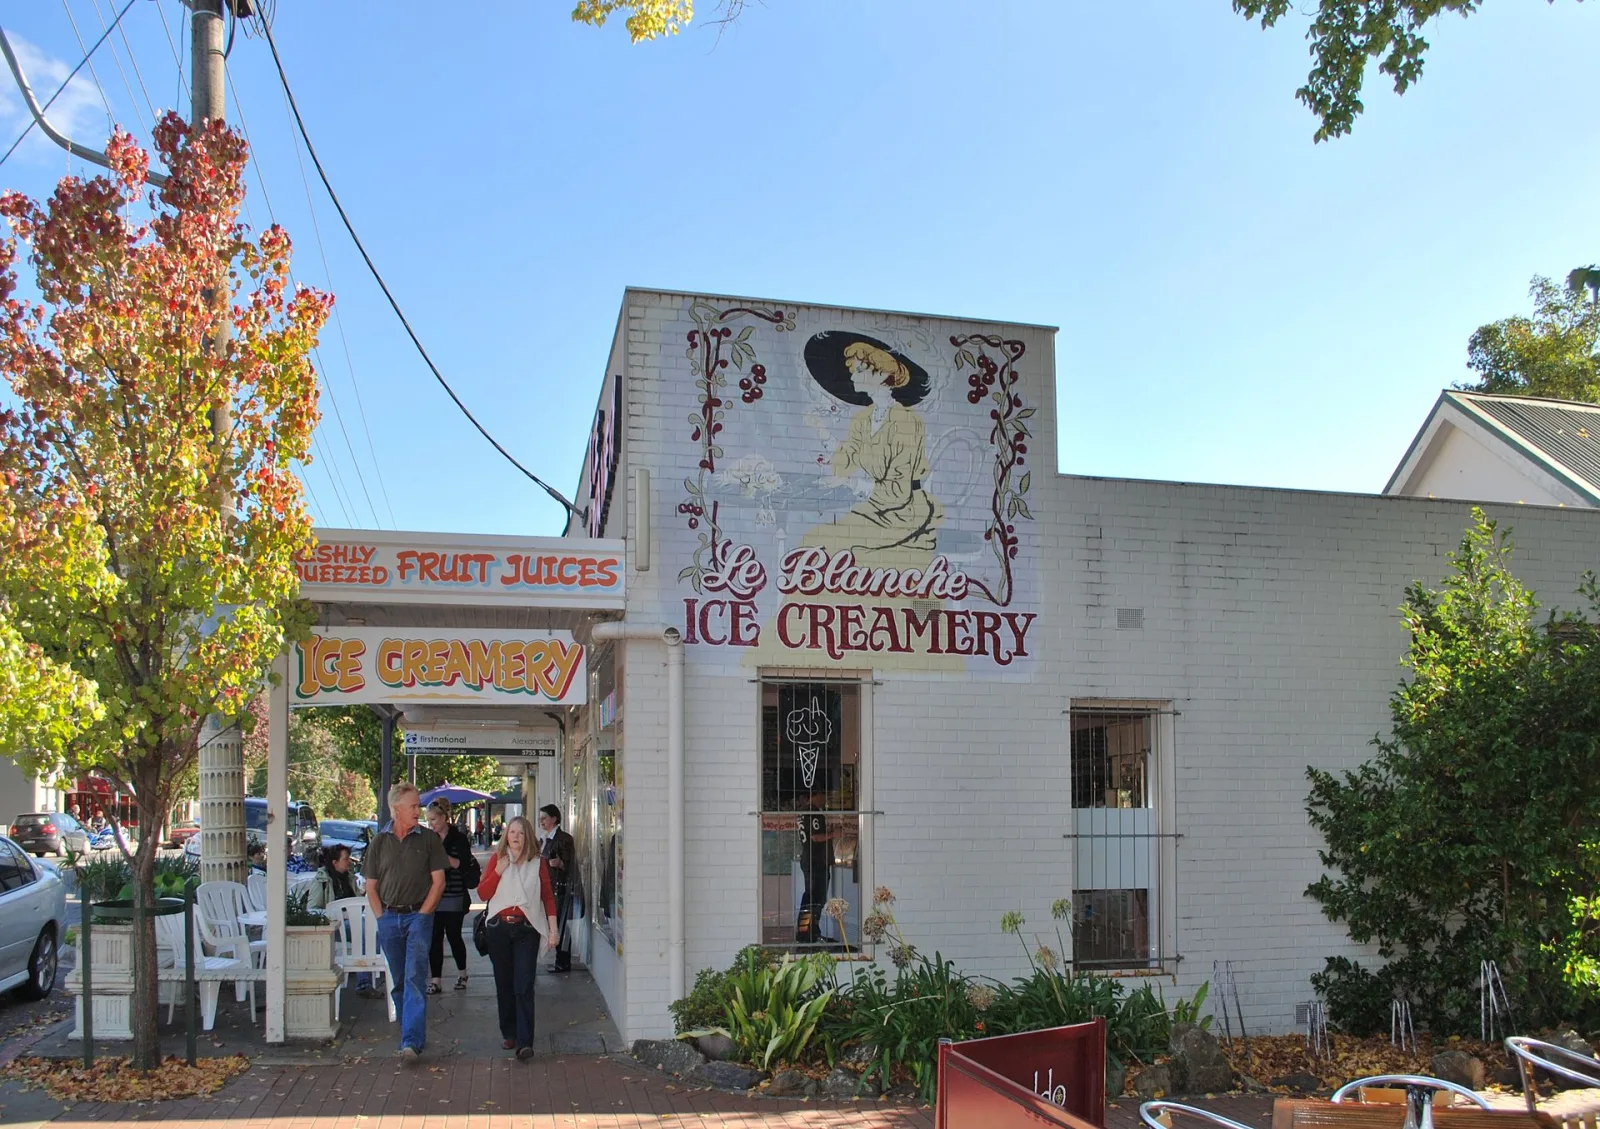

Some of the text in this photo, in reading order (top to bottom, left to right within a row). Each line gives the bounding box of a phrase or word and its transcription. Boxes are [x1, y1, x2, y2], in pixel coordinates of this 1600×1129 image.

[396, 550, 619, 587] FRUIT JUICES
[700, 539, 969, 600] Le Blanche
[683, 598, 1037, 665] ICE CREAMERY
[298, 634, 584, 699] ICE CREAMERY
[420, 735, 467, 744] firstnational
[812, 817, 820, 831] 6
